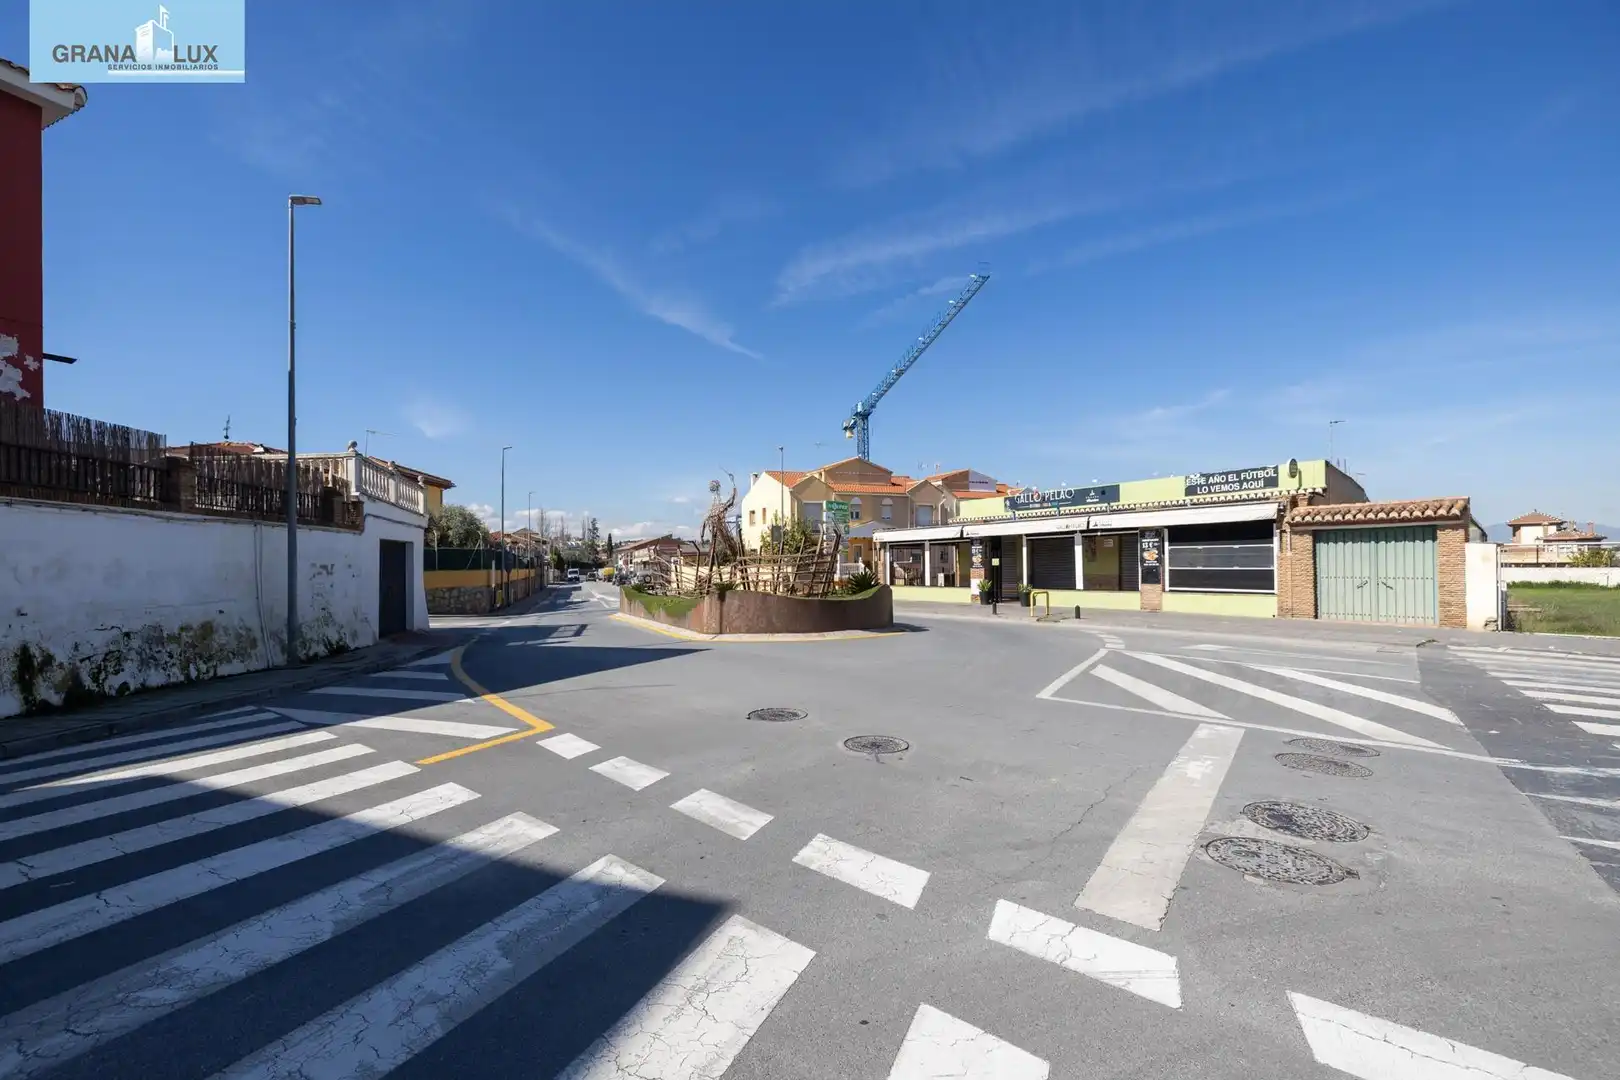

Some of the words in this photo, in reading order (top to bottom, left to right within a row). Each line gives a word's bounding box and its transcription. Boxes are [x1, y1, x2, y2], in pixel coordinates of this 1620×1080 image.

[1186, 477, 1206, 486] ESTE
[1208, 474, 1226, 484] AÑO
[1228, 473, 1239, 482] EL
[1241, 468, 1277, 480] FÚTBOL
[1197, 486, 1208, 494] LO
[1210, 483, 1240, 493] VEMOS
[1242, 478, 1264, 490] AQUÍ
[1015, 492, 1042, 504] GALLO
[1044, 488, 1074, 501] PELAO
